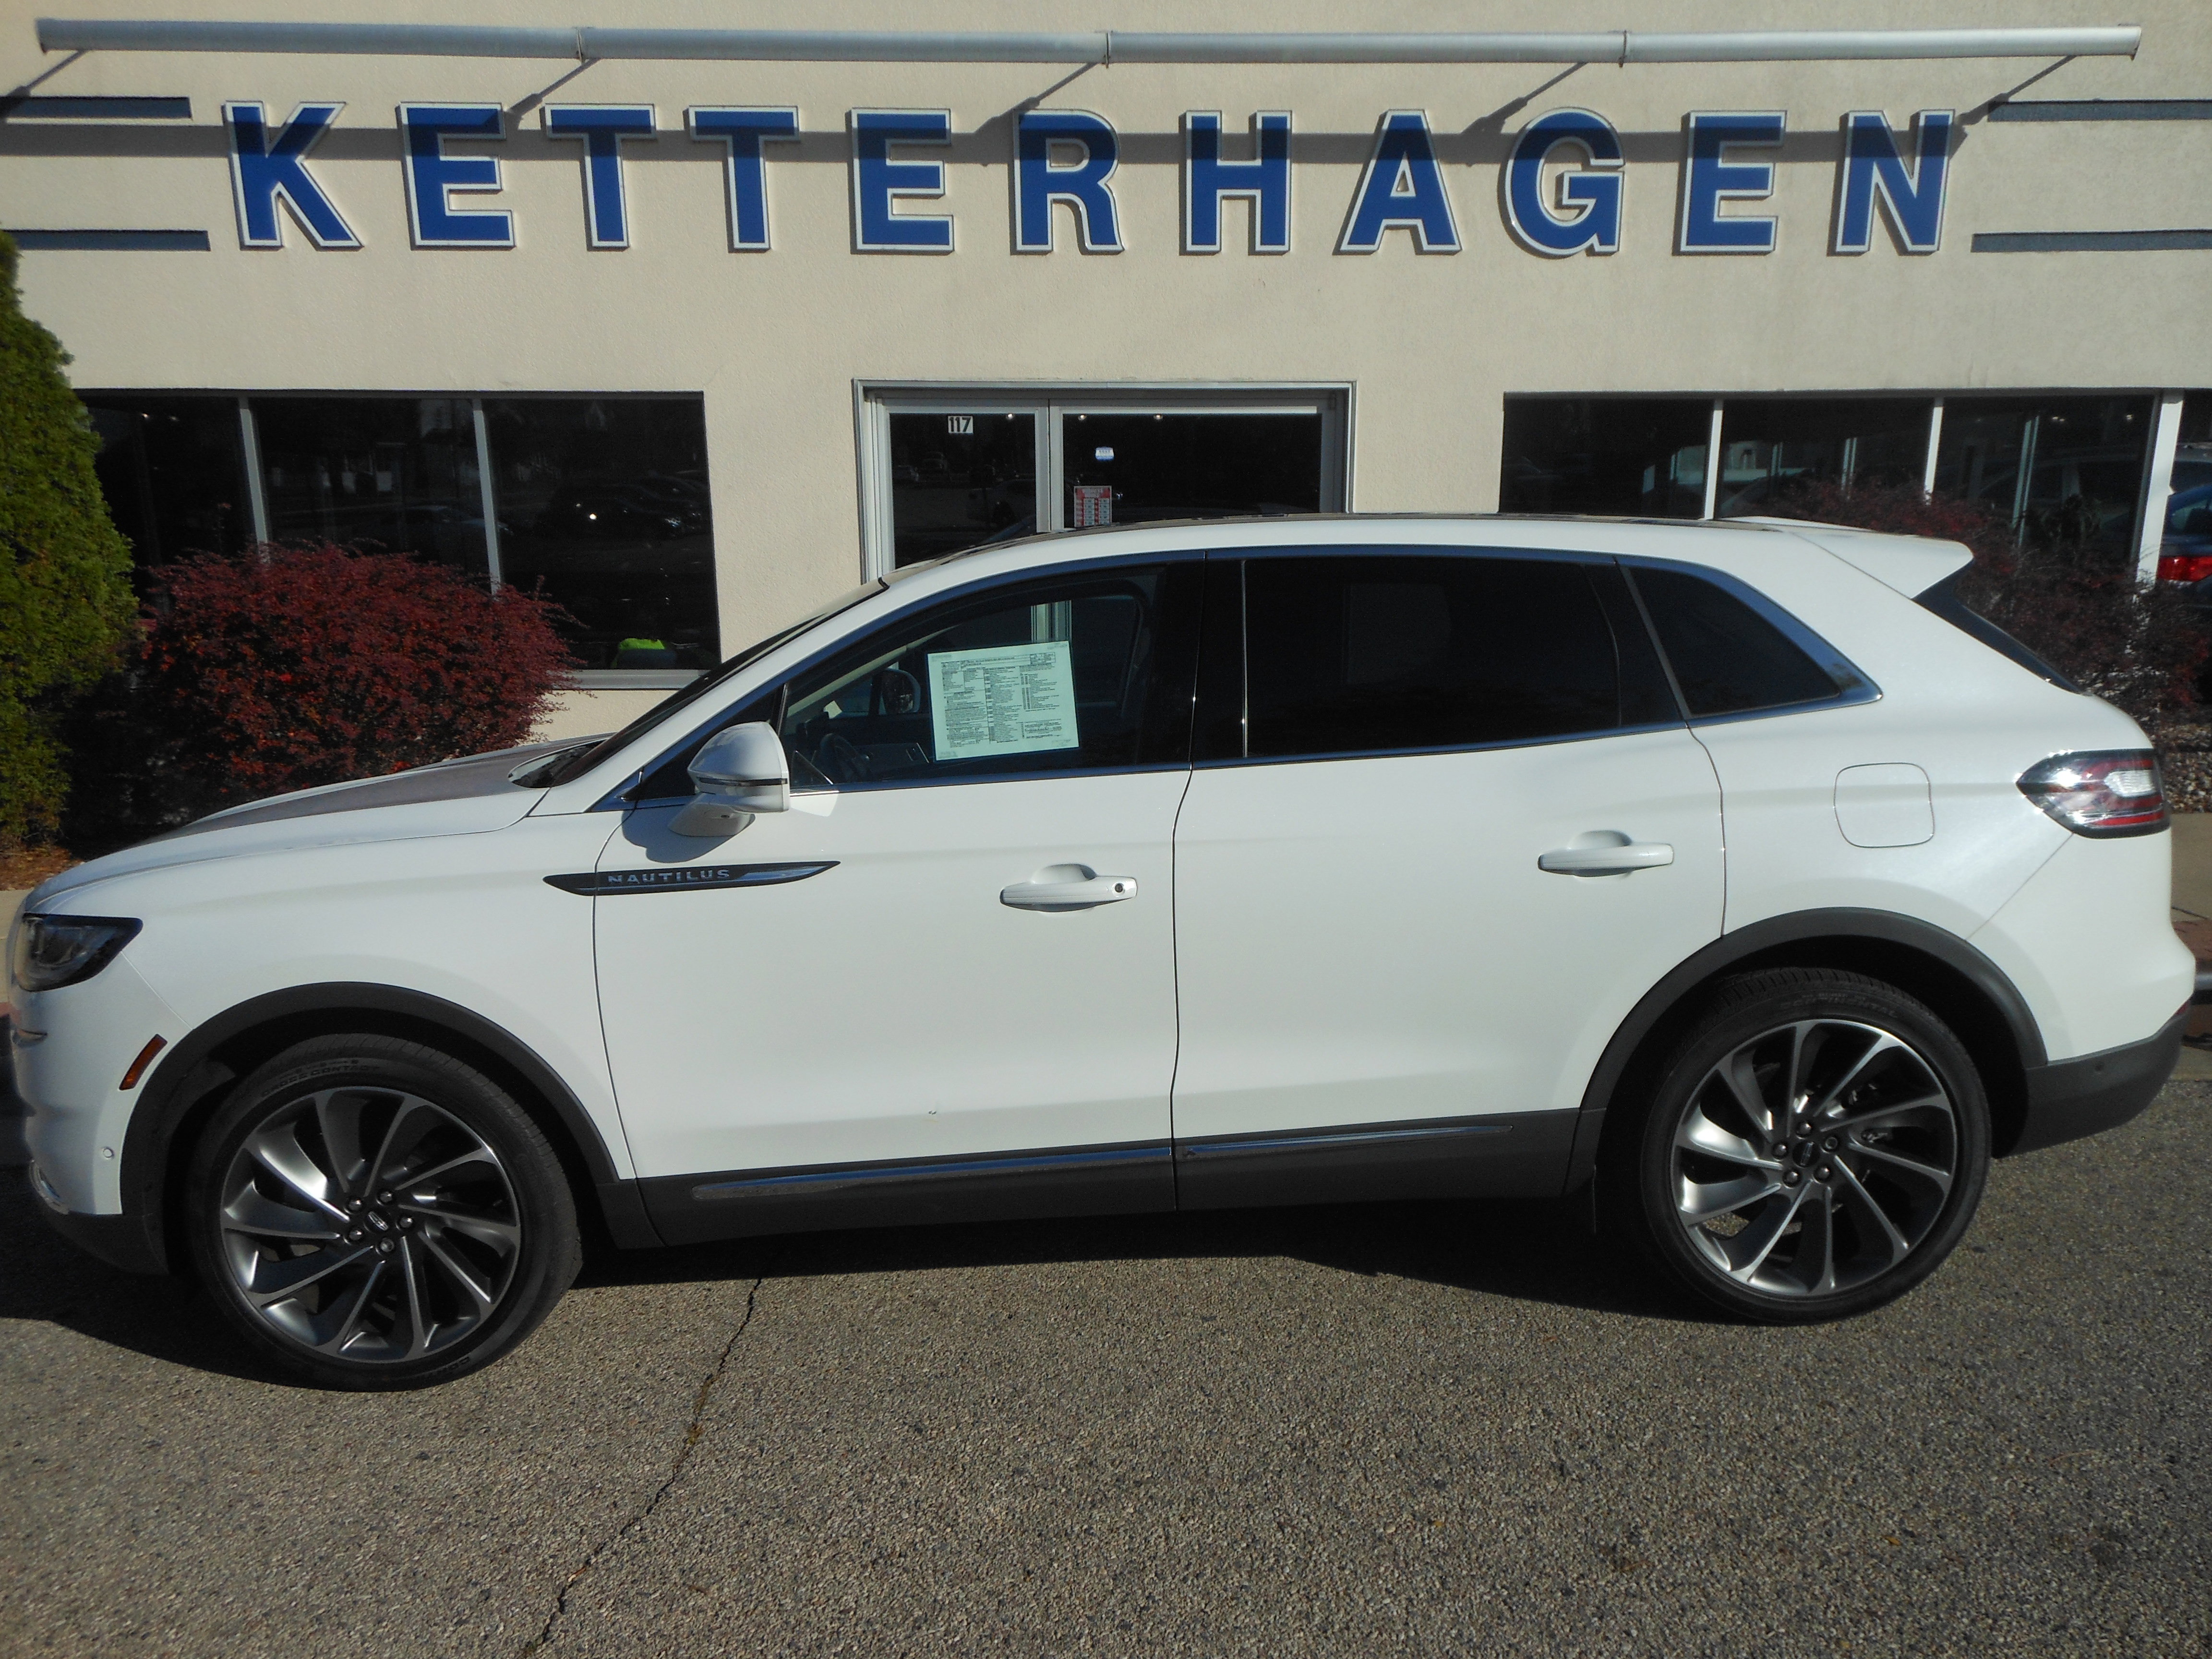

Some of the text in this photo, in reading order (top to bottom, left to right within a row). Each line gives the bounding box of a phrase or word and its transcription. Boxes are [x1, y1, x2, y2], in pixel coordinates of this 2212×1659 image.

[224, 101, 1955, 256] KETTERHAGEN
[949, 416, 971, 433] 117
[607, 869, 730, 884] NAUTILUS
